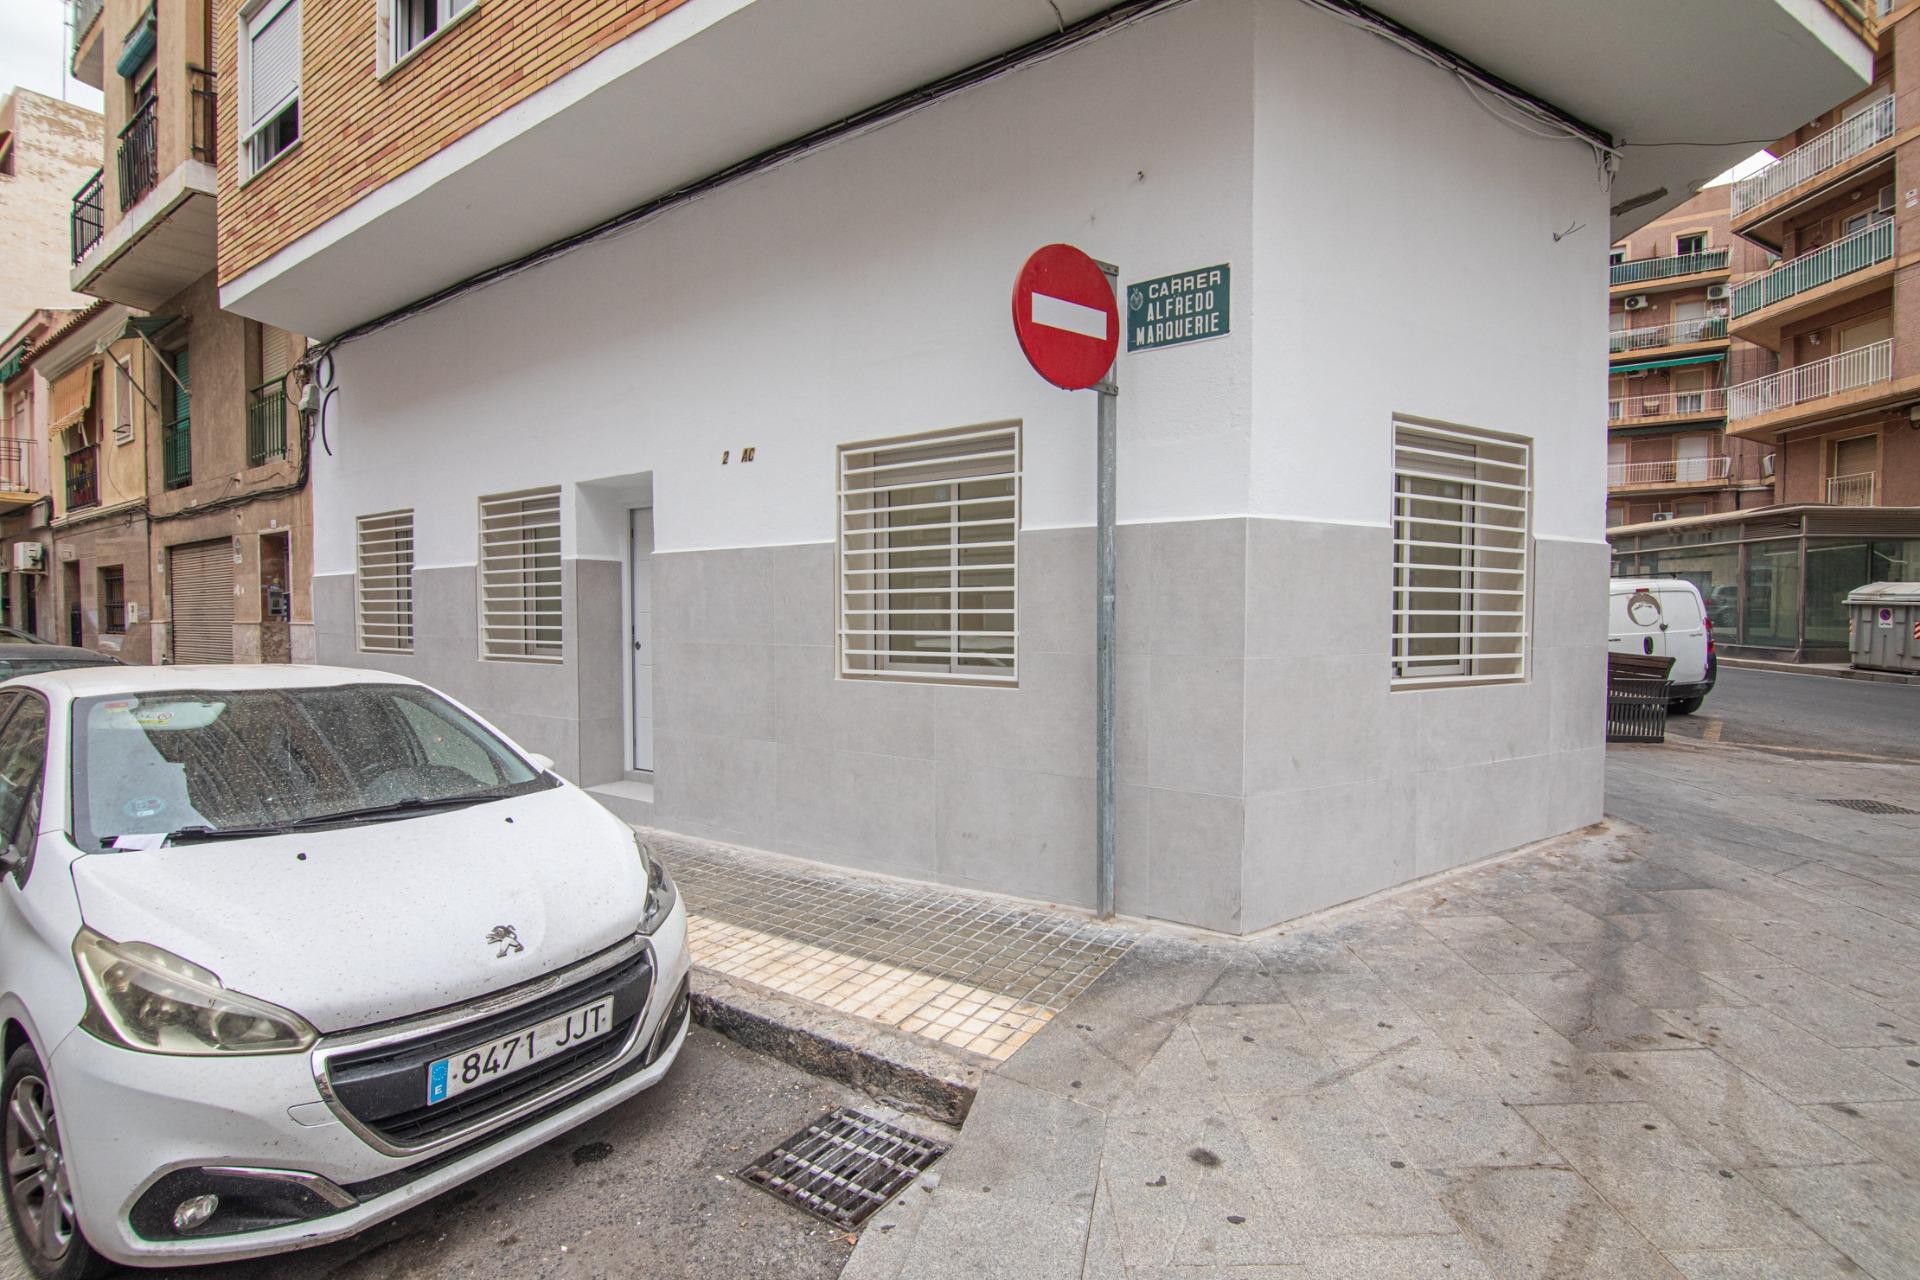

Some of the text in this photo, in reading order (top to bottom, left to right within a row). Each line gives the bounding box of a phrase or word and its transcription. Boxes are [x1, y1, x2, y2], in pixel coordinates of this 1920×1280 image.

[1148, 270, 1221, 299] CARRER
[1147, 290, 1214, 322] ALFREDO
[1136, 312, 1219, 346] MARQUERIE
[434, 1003, 605, 1096] E 8471 JJT
